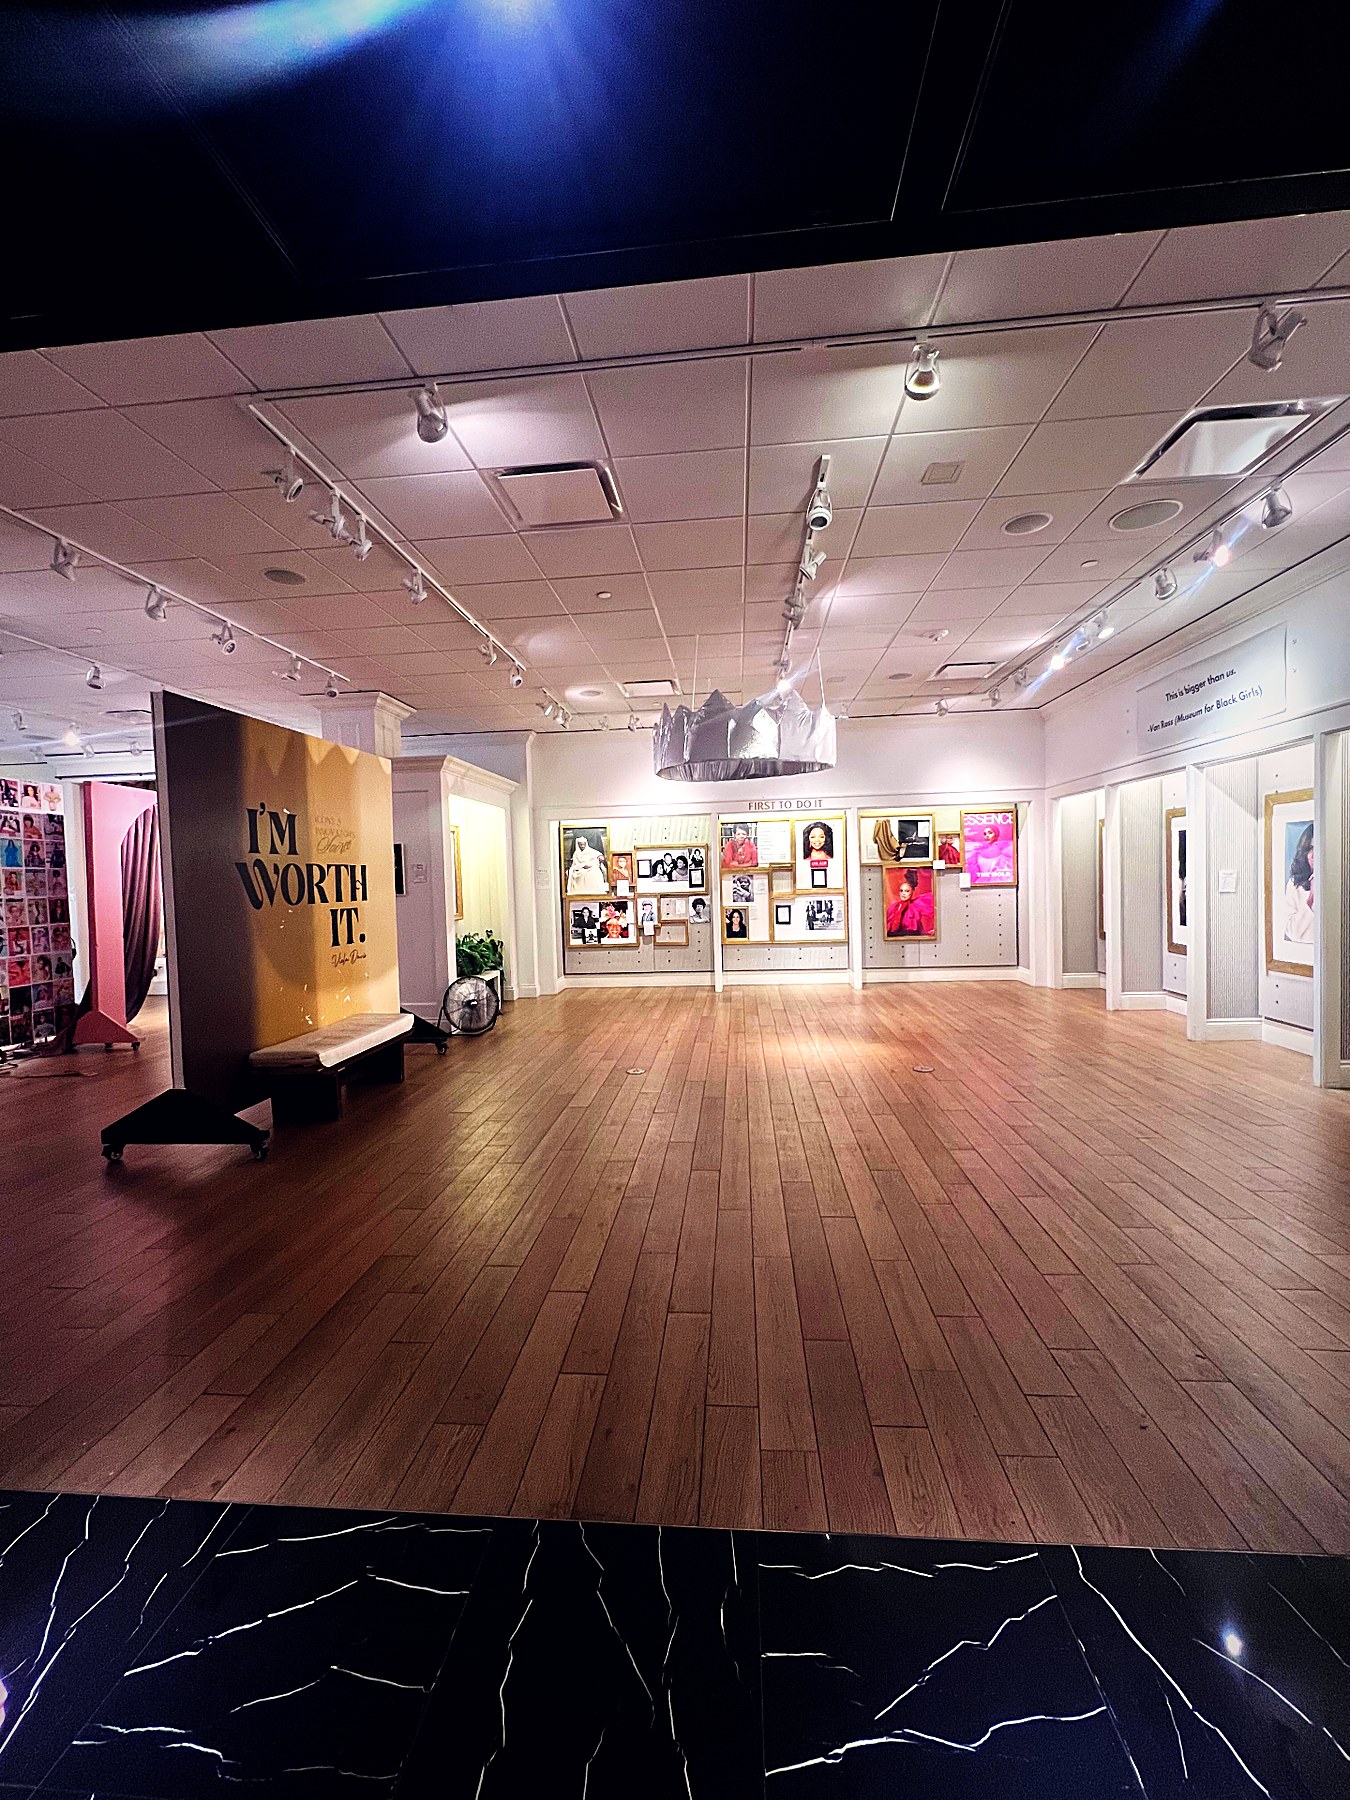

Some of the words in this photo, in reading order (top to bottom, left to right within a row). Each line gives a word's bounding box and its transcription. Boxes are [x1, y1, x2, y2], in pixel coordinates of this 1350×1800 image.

[1165, 691, 1178, 702] This
[1178, 688, 1184, 697] is
[1184, 682, 1206, 695] bigger
[1207, 673, 1225, 685] than
[1226, 669, 1236, 677] us.
[1174, 709, 1202, 726] (Museum
[1204, 704, 1214, 714] for
[1216, 694, 1237, 709] Black
[1238, 685, 1263, 701] Girls)
[748, 801, 775, 810] FIRST
[779, 800, 792, 809] TO
[796, 800, 812, 809] DO
[814, 799, 822, 808] IT
[234, 858, 368, 910] WORTH
[329, 907, 366, 947] IT.
